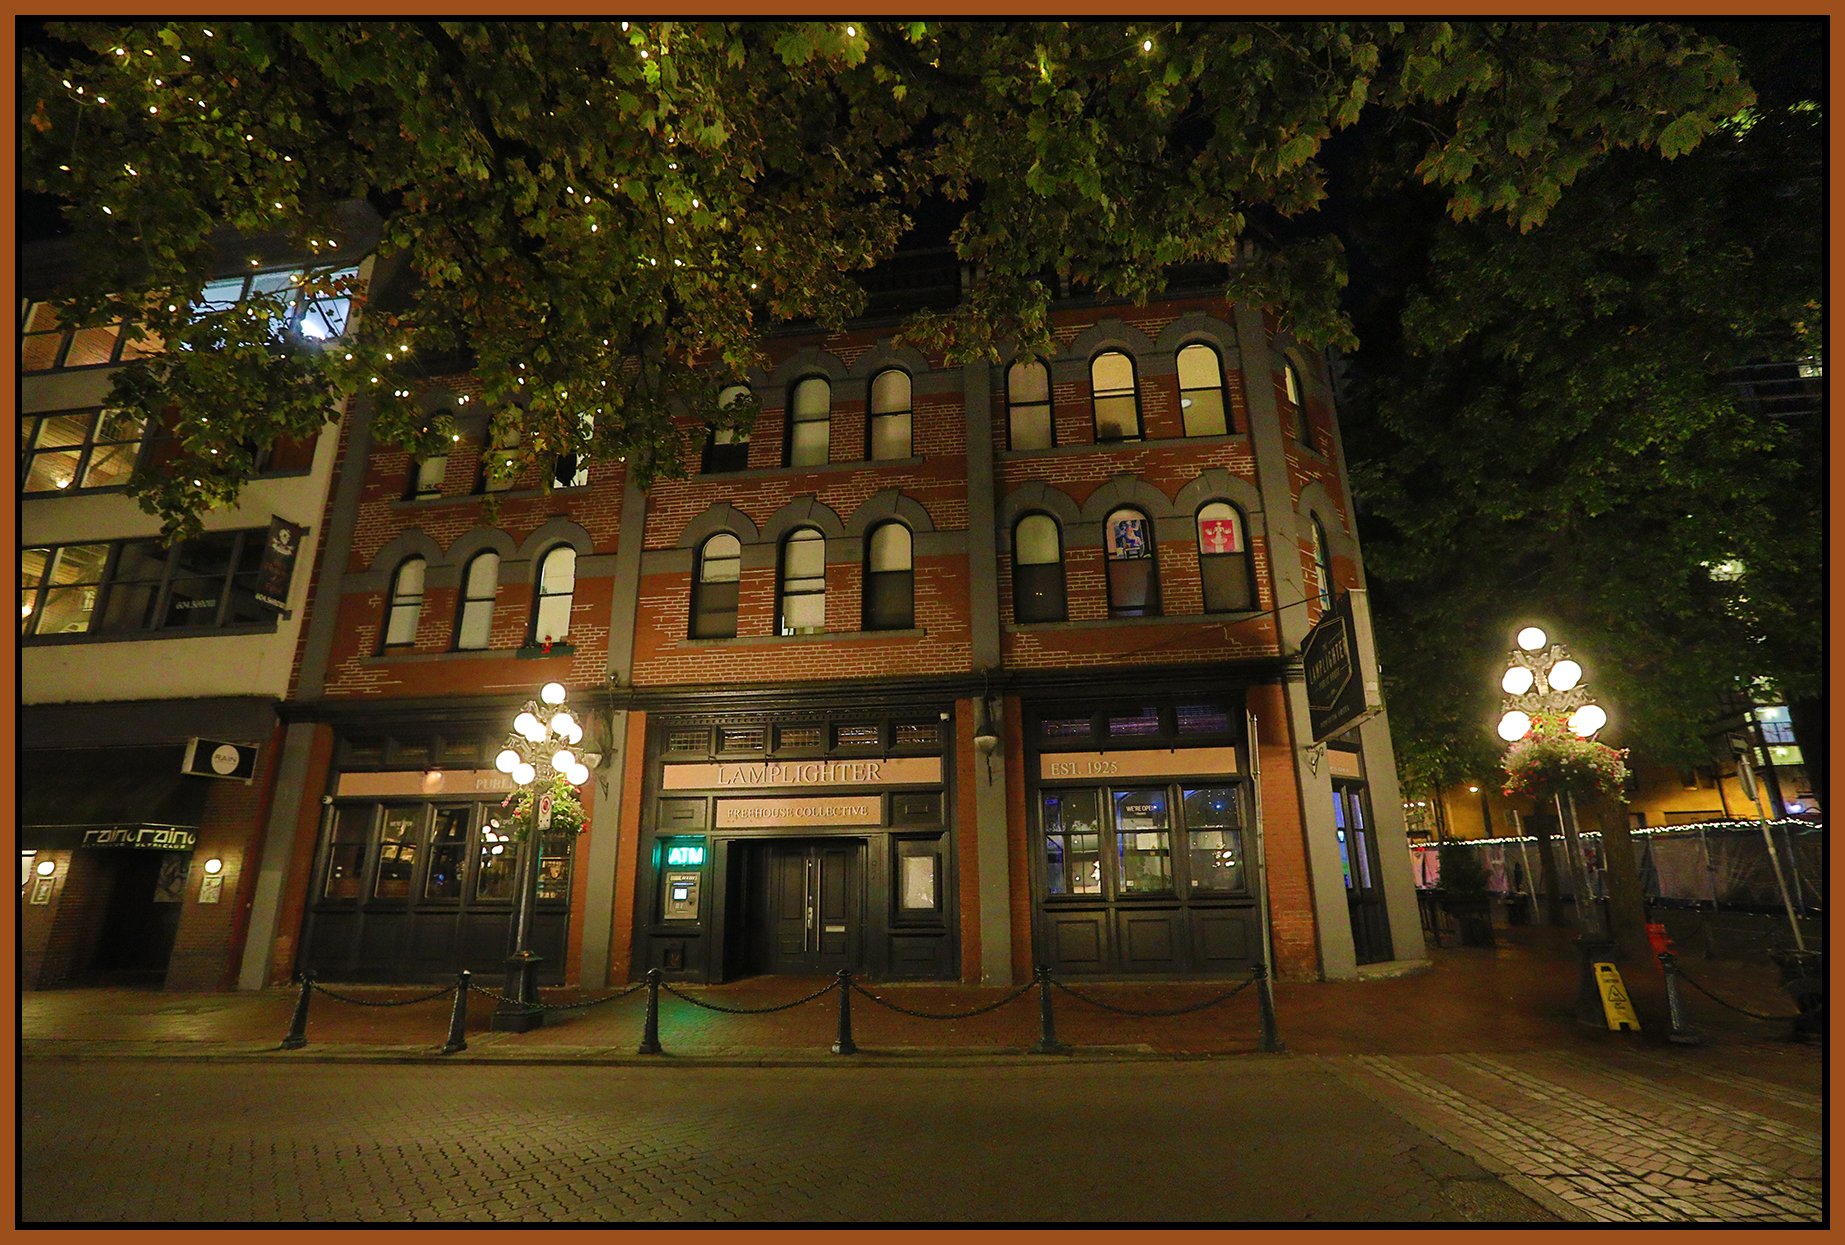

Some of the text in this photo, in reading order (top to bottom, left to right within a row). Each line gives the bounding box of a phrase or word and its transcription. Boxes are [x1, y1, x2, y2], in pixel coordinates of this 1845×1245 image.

[214, 754, 238, 763] RAIN
[717, 761, 882, 785] LAMPLIGHTER
[1051, 761, 1118, 776] EST. 1925
[727, 805, 869, 819] FREEHOUSE COLLECTIVE
[136, 828, 188, 844] rain
[668, 846, 704, 865] ATM
